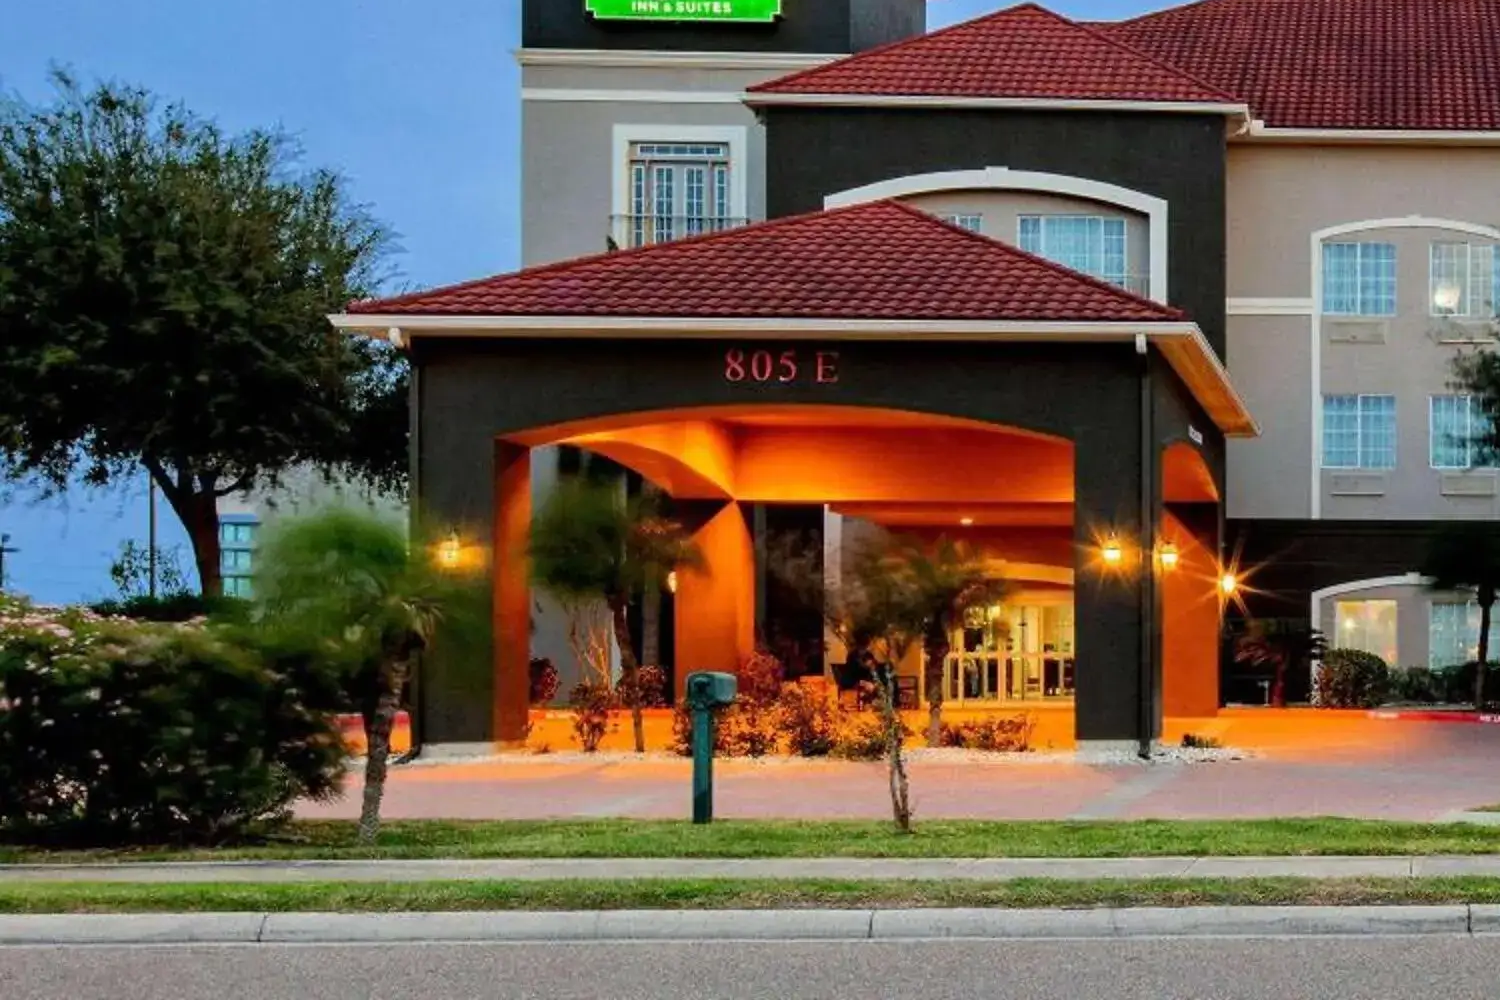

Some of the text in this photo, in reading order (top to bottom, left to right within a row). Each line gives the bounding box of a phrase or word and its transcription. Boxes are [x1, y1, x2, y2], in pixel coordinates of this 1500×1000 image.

[631, 0, 732, 14] INN & SUITES
[725, 349, 839, 383] 805 E
